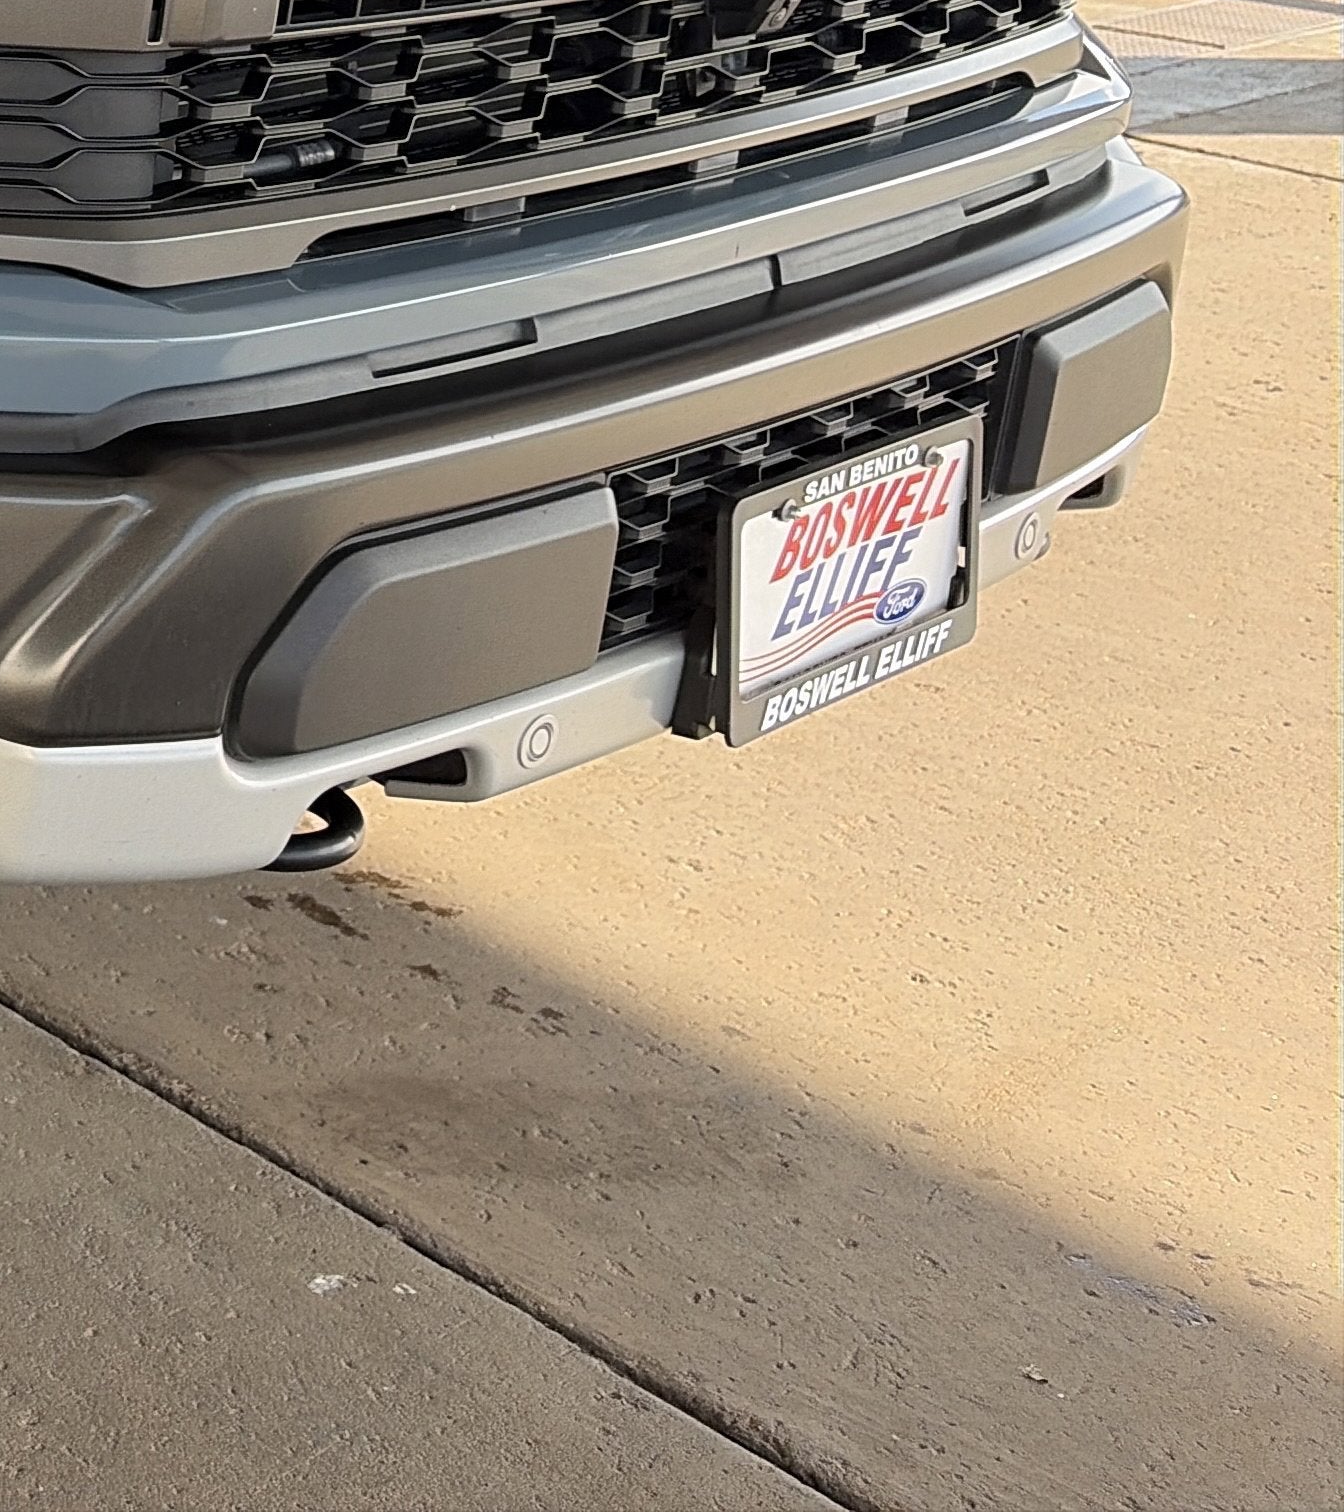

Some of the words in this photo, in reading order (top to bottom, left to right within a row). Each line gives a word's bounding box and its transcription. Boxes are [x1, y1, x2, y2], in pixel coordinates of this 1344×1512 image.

[769, 458, 960, 584] BOSWELL
[804, 472, 844, 502] SAN
[849, 444, 919, 484] BENITO
[771, 526, 923, 641] ELLIFF
[883, 588, 916, 620] Ford
[761, 655, 870, 731] BOSWELL
[875, 620, 953, 674] ELLIFF
